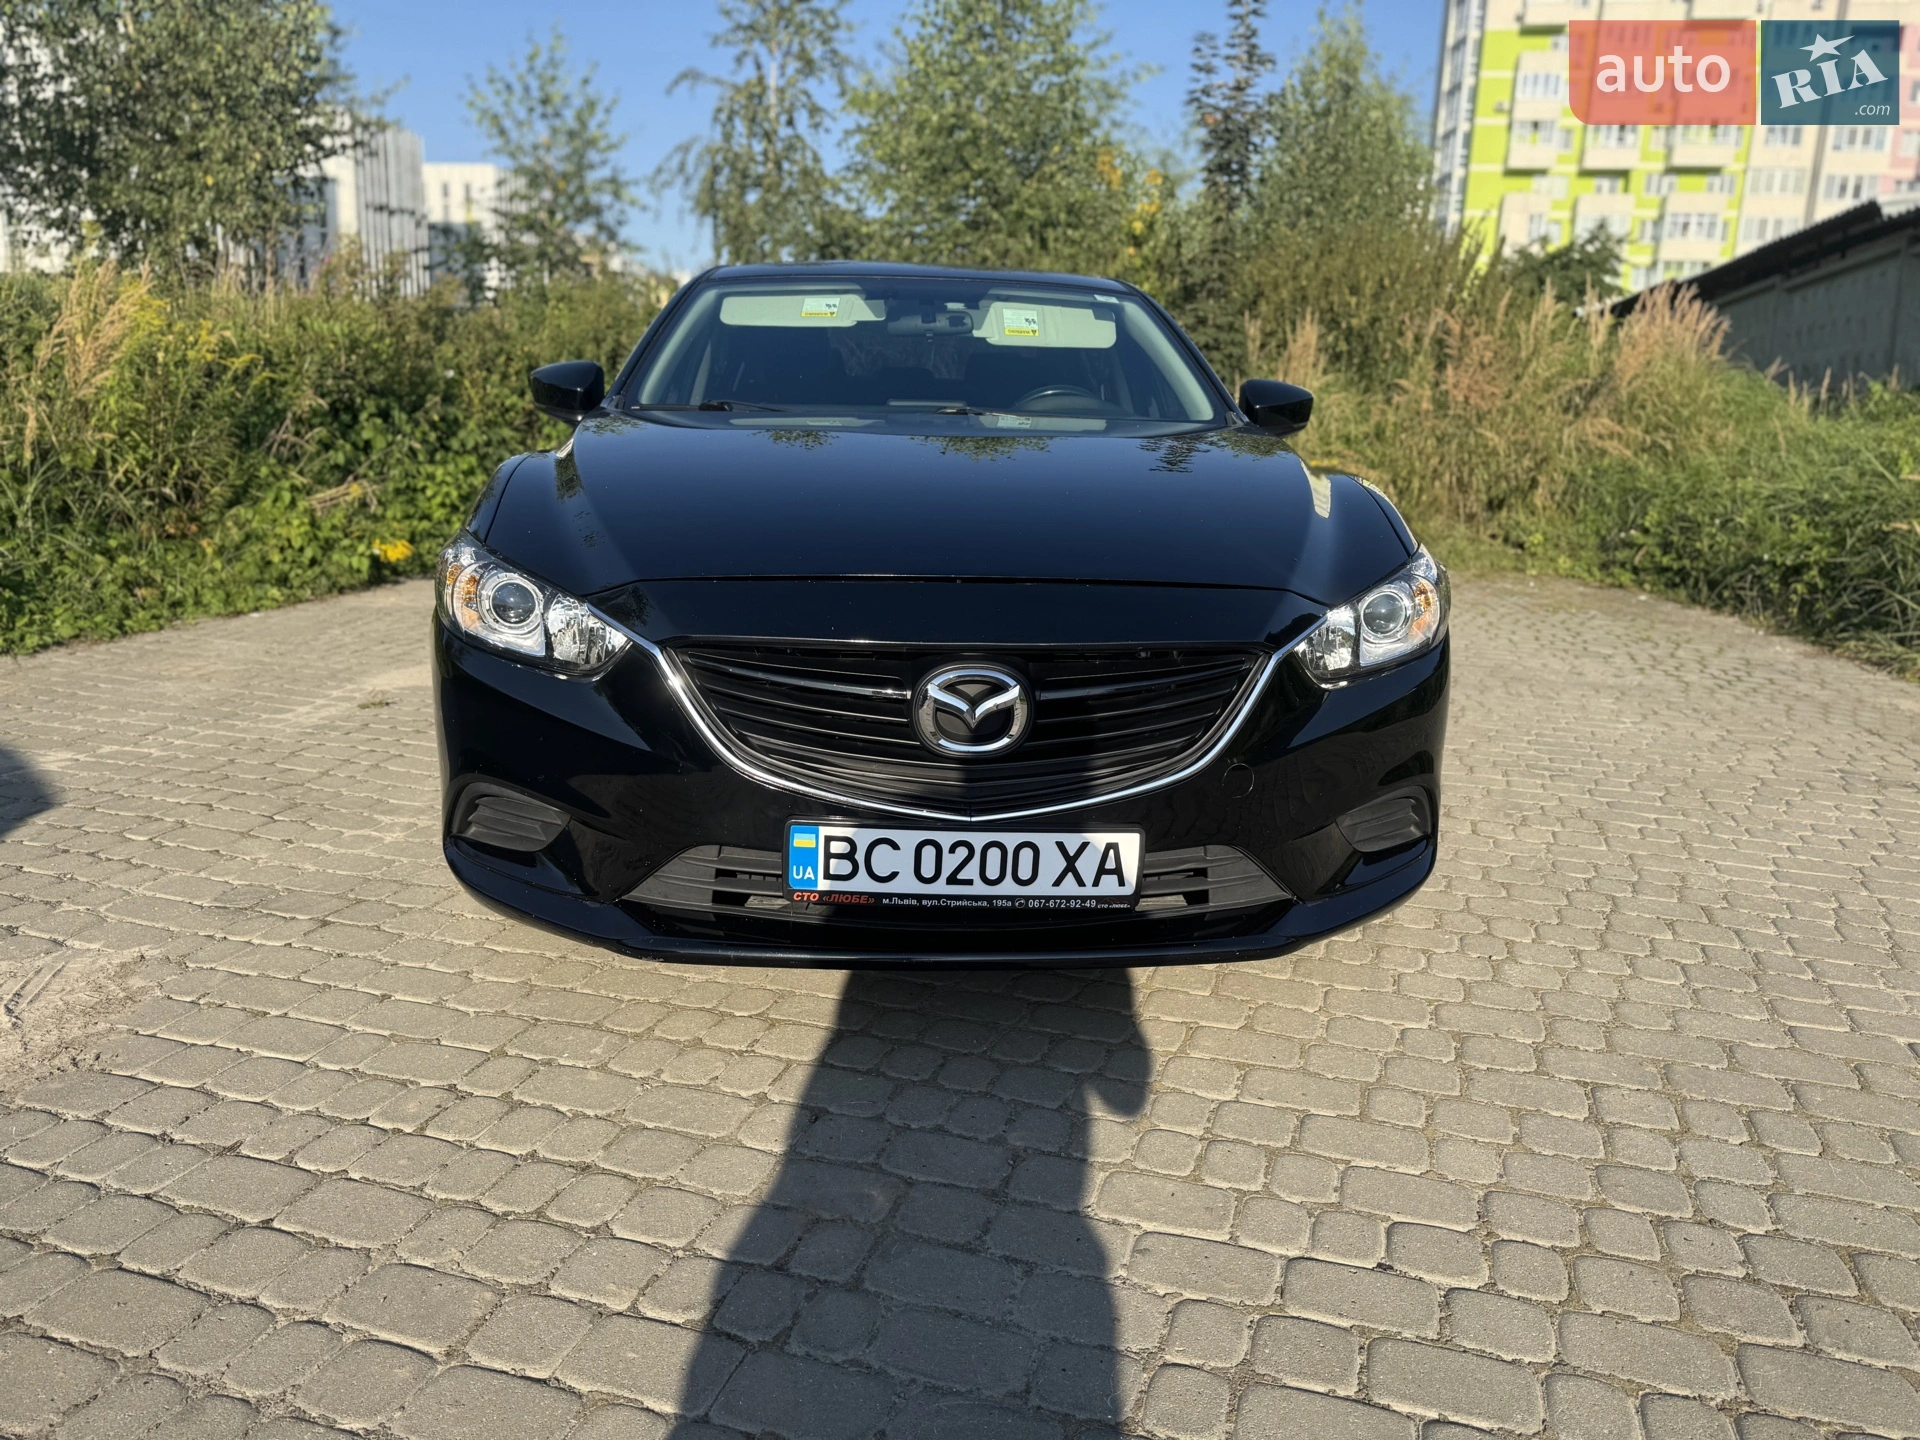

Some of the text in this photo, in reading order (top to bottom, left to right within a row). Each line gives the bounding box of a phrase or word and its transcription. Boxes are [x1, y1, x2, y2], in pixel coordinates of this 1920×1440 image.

[823, 835, 1125, 887] BC 0200 XA
[793, 865, 815, 880] UA
[1028, 899, 1097, 908] 067-672-92-49
